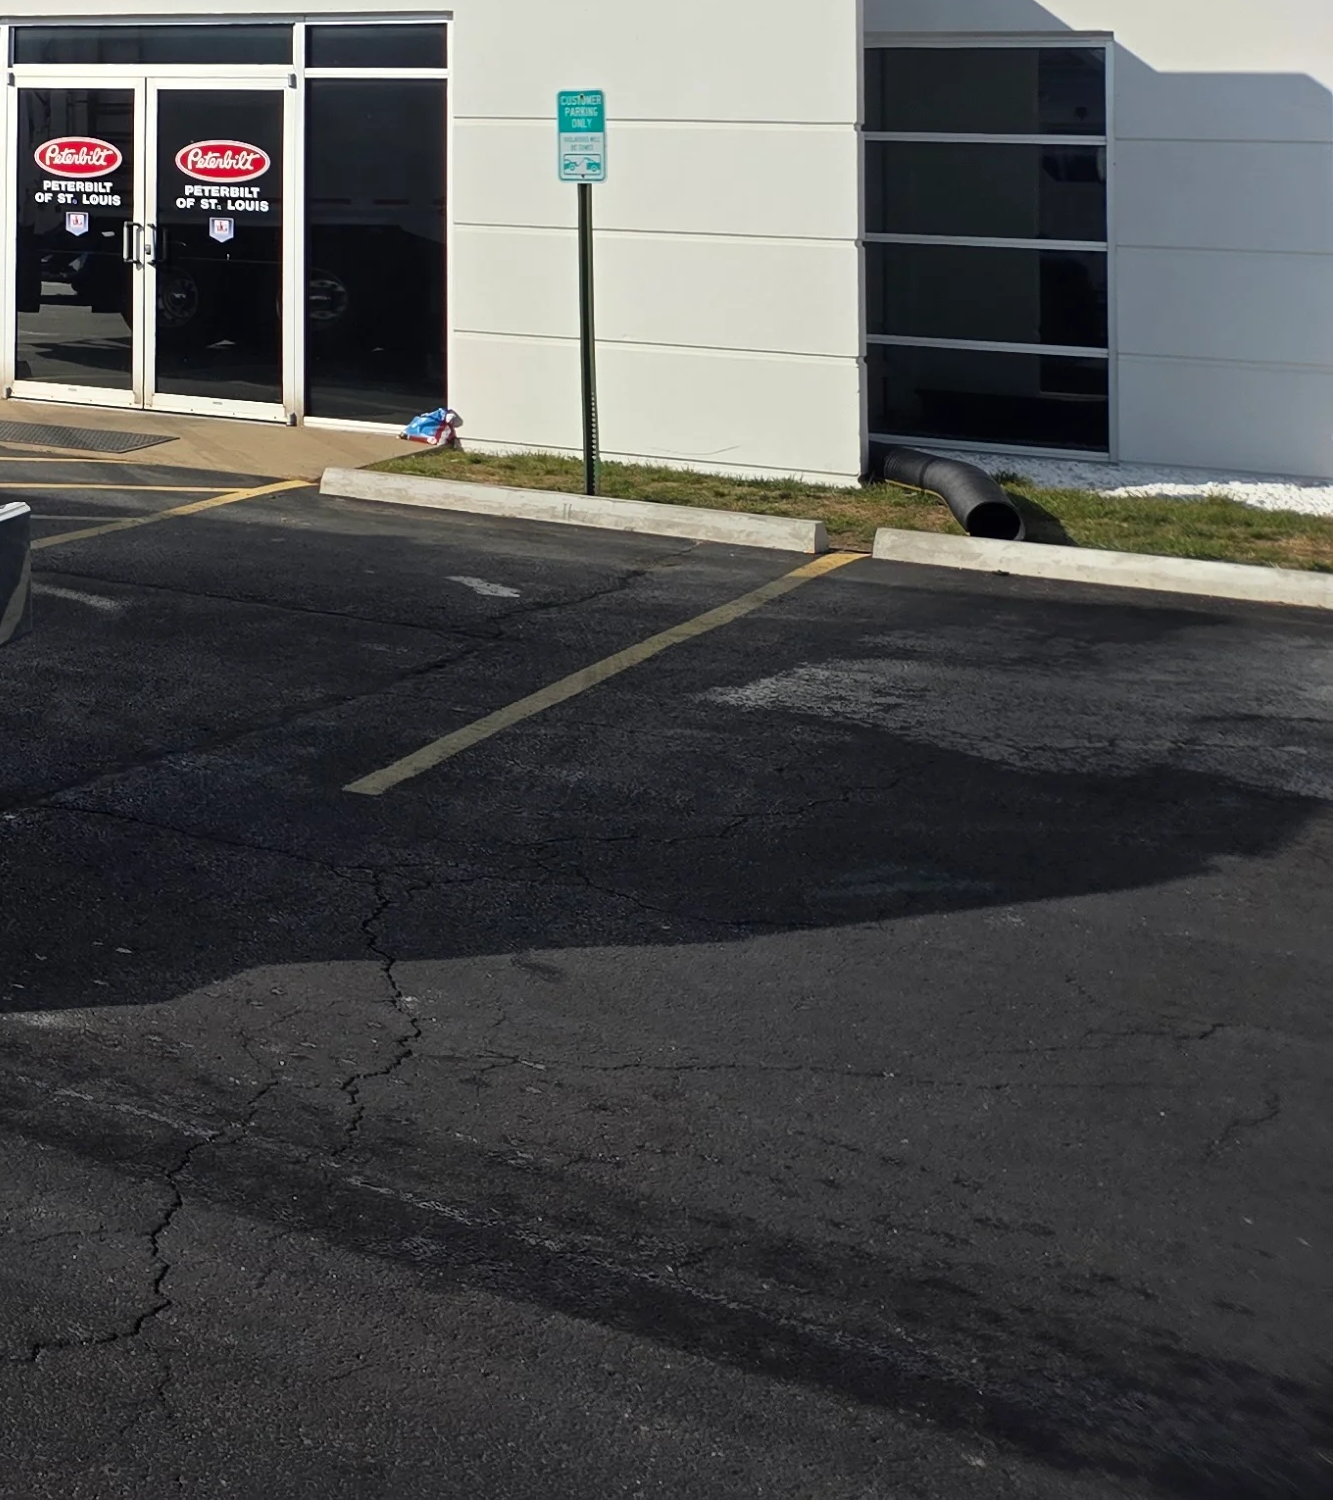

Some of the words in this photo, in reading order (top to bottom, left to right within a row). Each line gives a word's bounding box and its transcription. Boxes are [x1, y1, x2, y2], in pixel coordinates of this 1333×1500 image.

[560, 94, 602, 106] CUSTOMER
[564, 106, 599, 117] PARKING
[571, 118, 593, 129] ONLY
[45, 144, 114, 166] Peterbilt
[187, 147, 262, 171] Peterbilt
[42, 180, 113, 193] PETERBILT
[184, 184, 261, 199] PETERBILT
[34, 192, 53, 203] OF
[57, 193, 78, 205] ST.
[82, 194, 121, 207] LOUIS
[176, 197, 196, 209] OF
[200, 198, 222, 210] ST.
[227, 199, 270, 212] LOUIS
